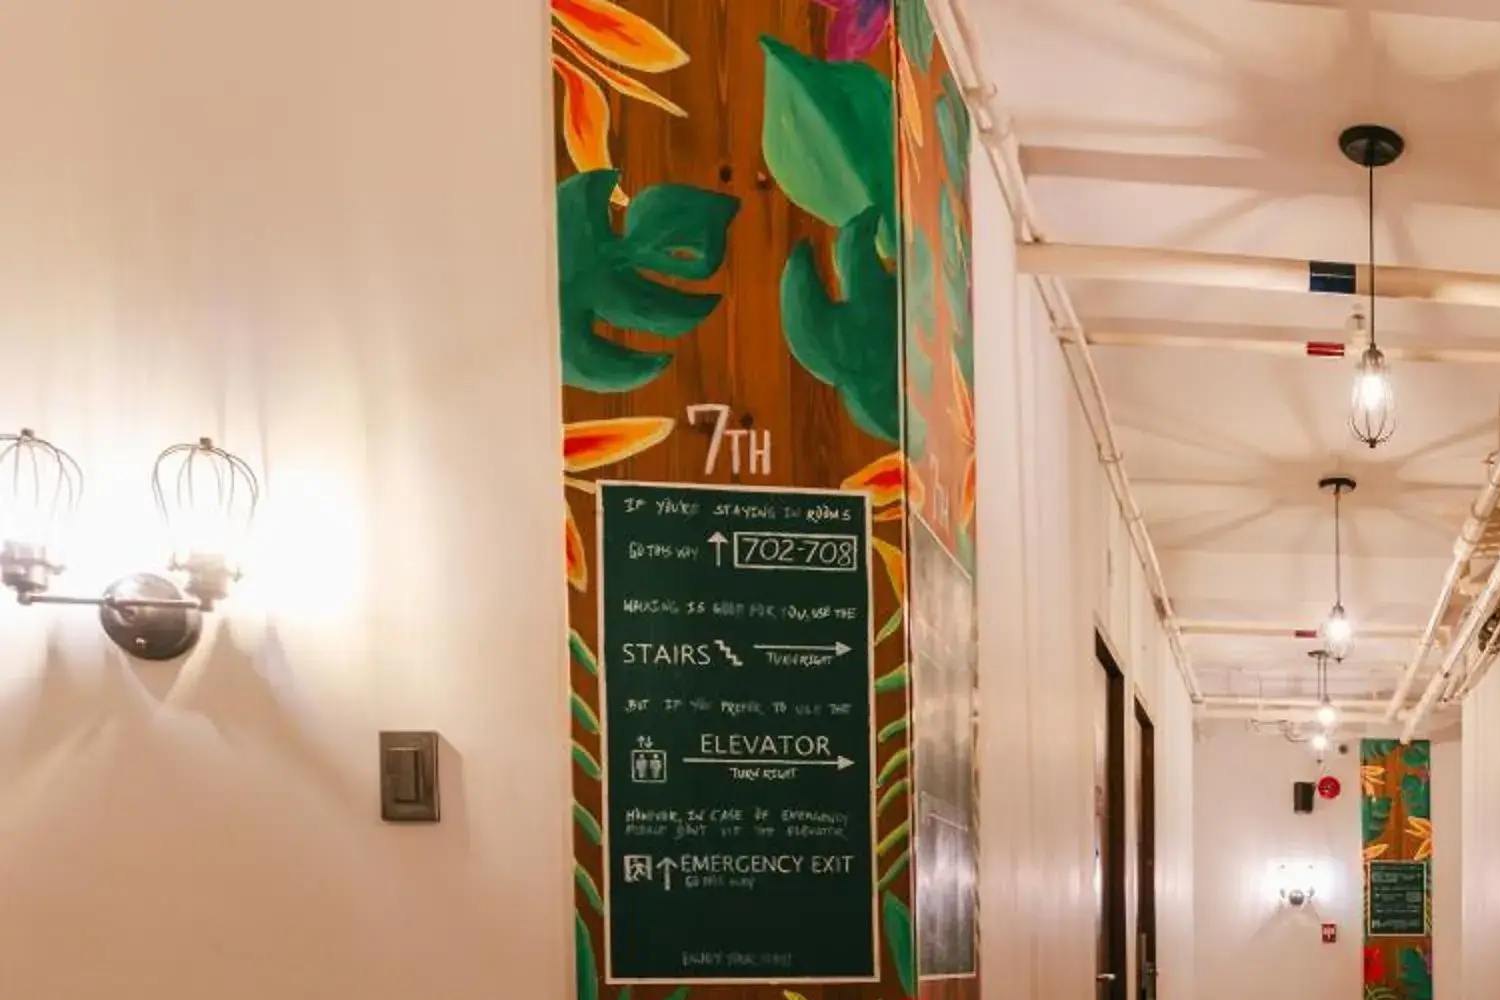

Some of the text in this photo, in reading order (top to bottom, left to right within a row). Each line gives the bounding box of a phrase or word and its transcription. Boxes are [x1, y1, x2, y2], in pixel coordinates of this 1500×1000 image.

[686, 403, 771, 476] 7TH
[806, 505, 851, 522] ROOMS
[741, 538, 852, 567] 702-708
[622, 643, 712, 666] STAIRS
[701, 733, 832, 756] ELEVATOR
[680, 854, 855, 875] EMERGENCY EXIT
